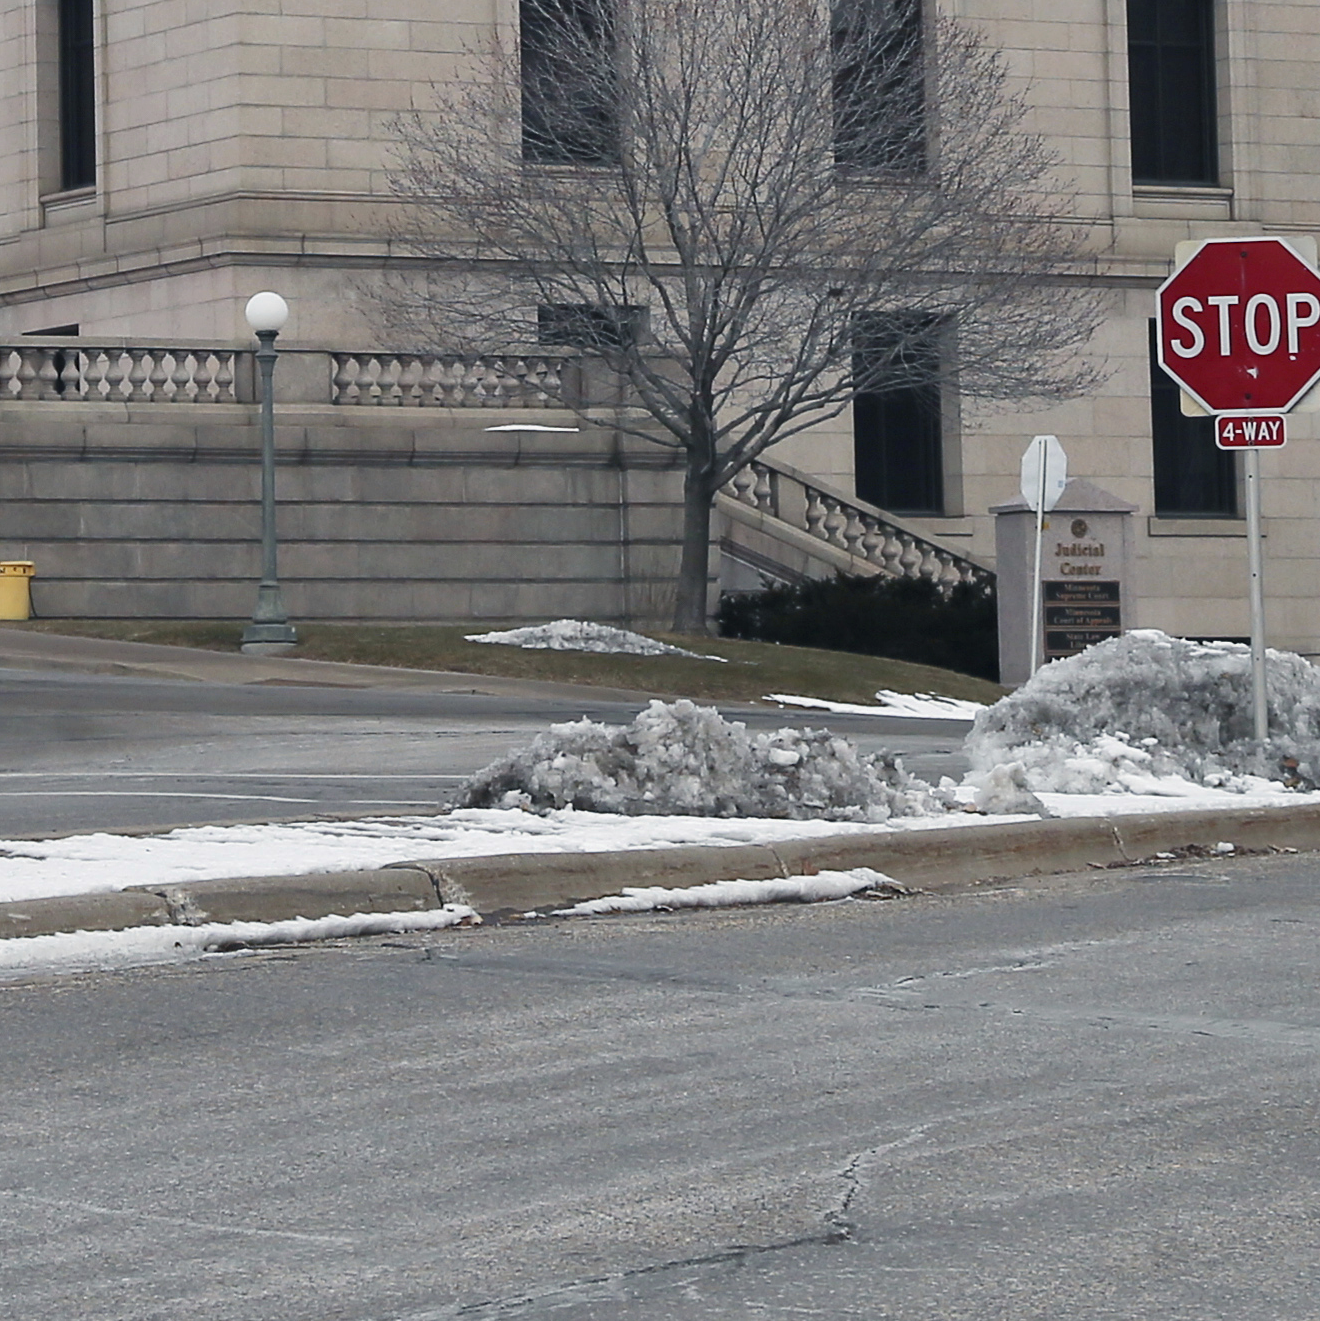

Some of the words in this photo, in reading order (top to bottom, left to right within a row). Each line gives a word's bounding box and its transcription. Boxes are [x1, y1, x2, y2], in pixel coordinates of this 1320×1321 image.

[1171, 292, 1320, 359] STOP
[1222, 420, 1281, 441] 4-WAY
[1054, 543, 1105, 557] Judicial
[1060, 562, 1102, 576] Center
